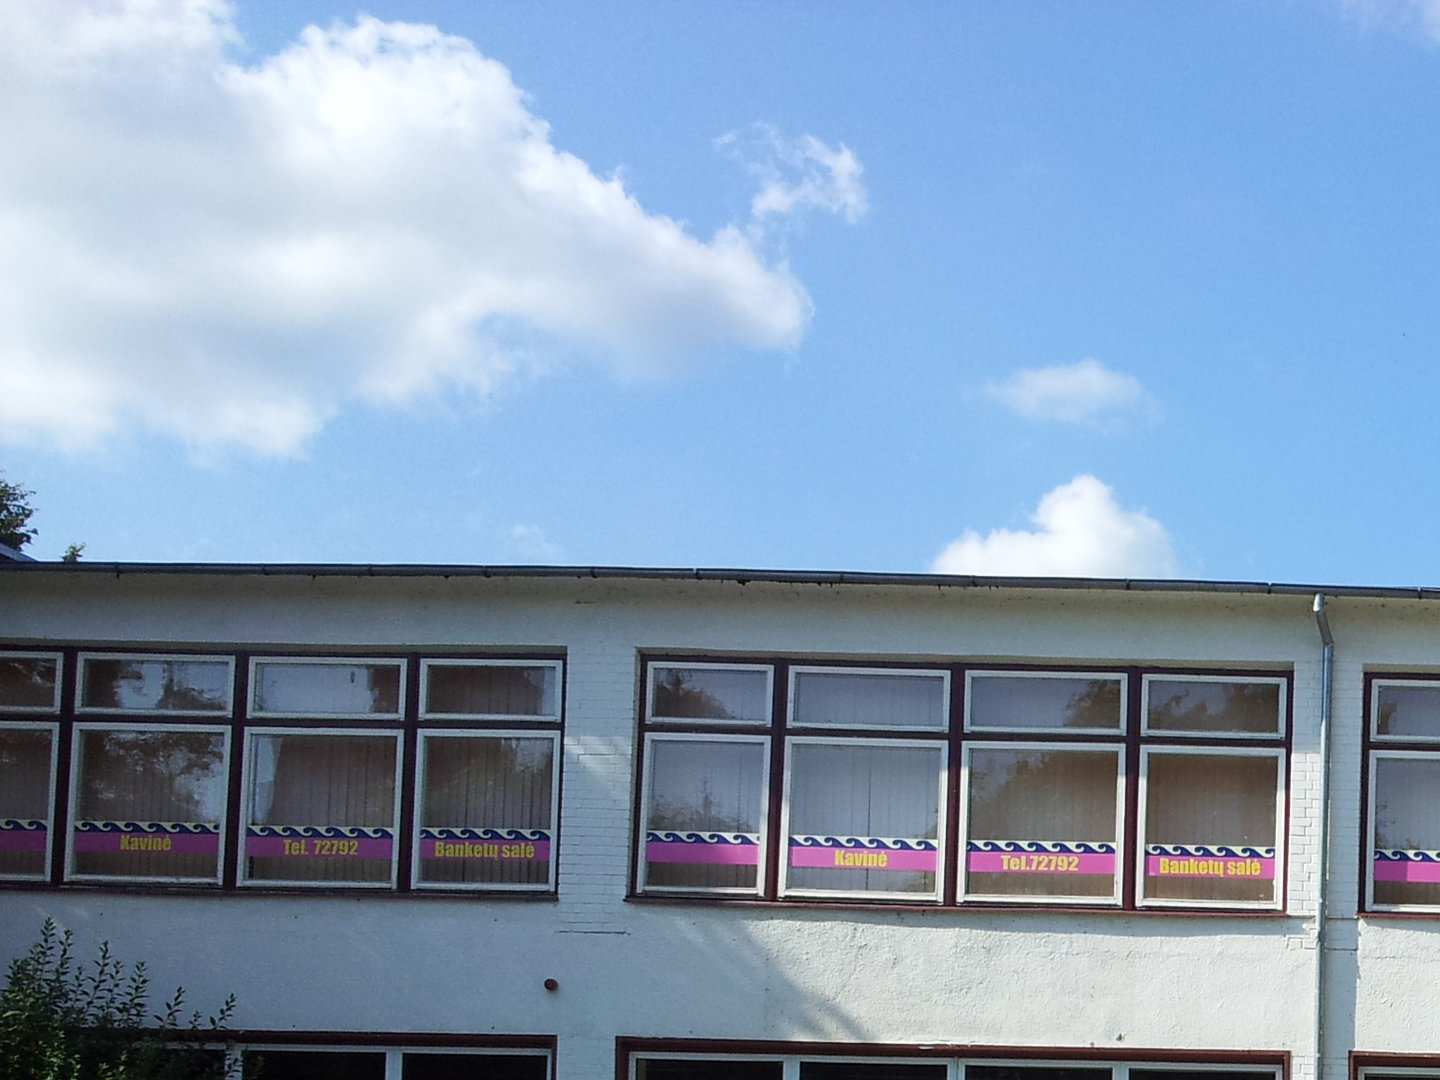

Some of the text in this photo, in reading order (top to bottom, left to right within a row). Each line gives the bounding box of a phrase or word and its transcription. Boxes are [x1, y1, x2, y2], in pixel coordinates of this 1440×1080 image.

[120, 834, 172, 852] Kavinė
[283, 837, 359, 857] Tel. 72792
[434, 841, 535, 860] Banketų salė
[834, 848, 888, 868] Kavinė
[1001, 855, 1079, 872] Tel.72792
[1159, 857, 1262, 878] Banketų salė
